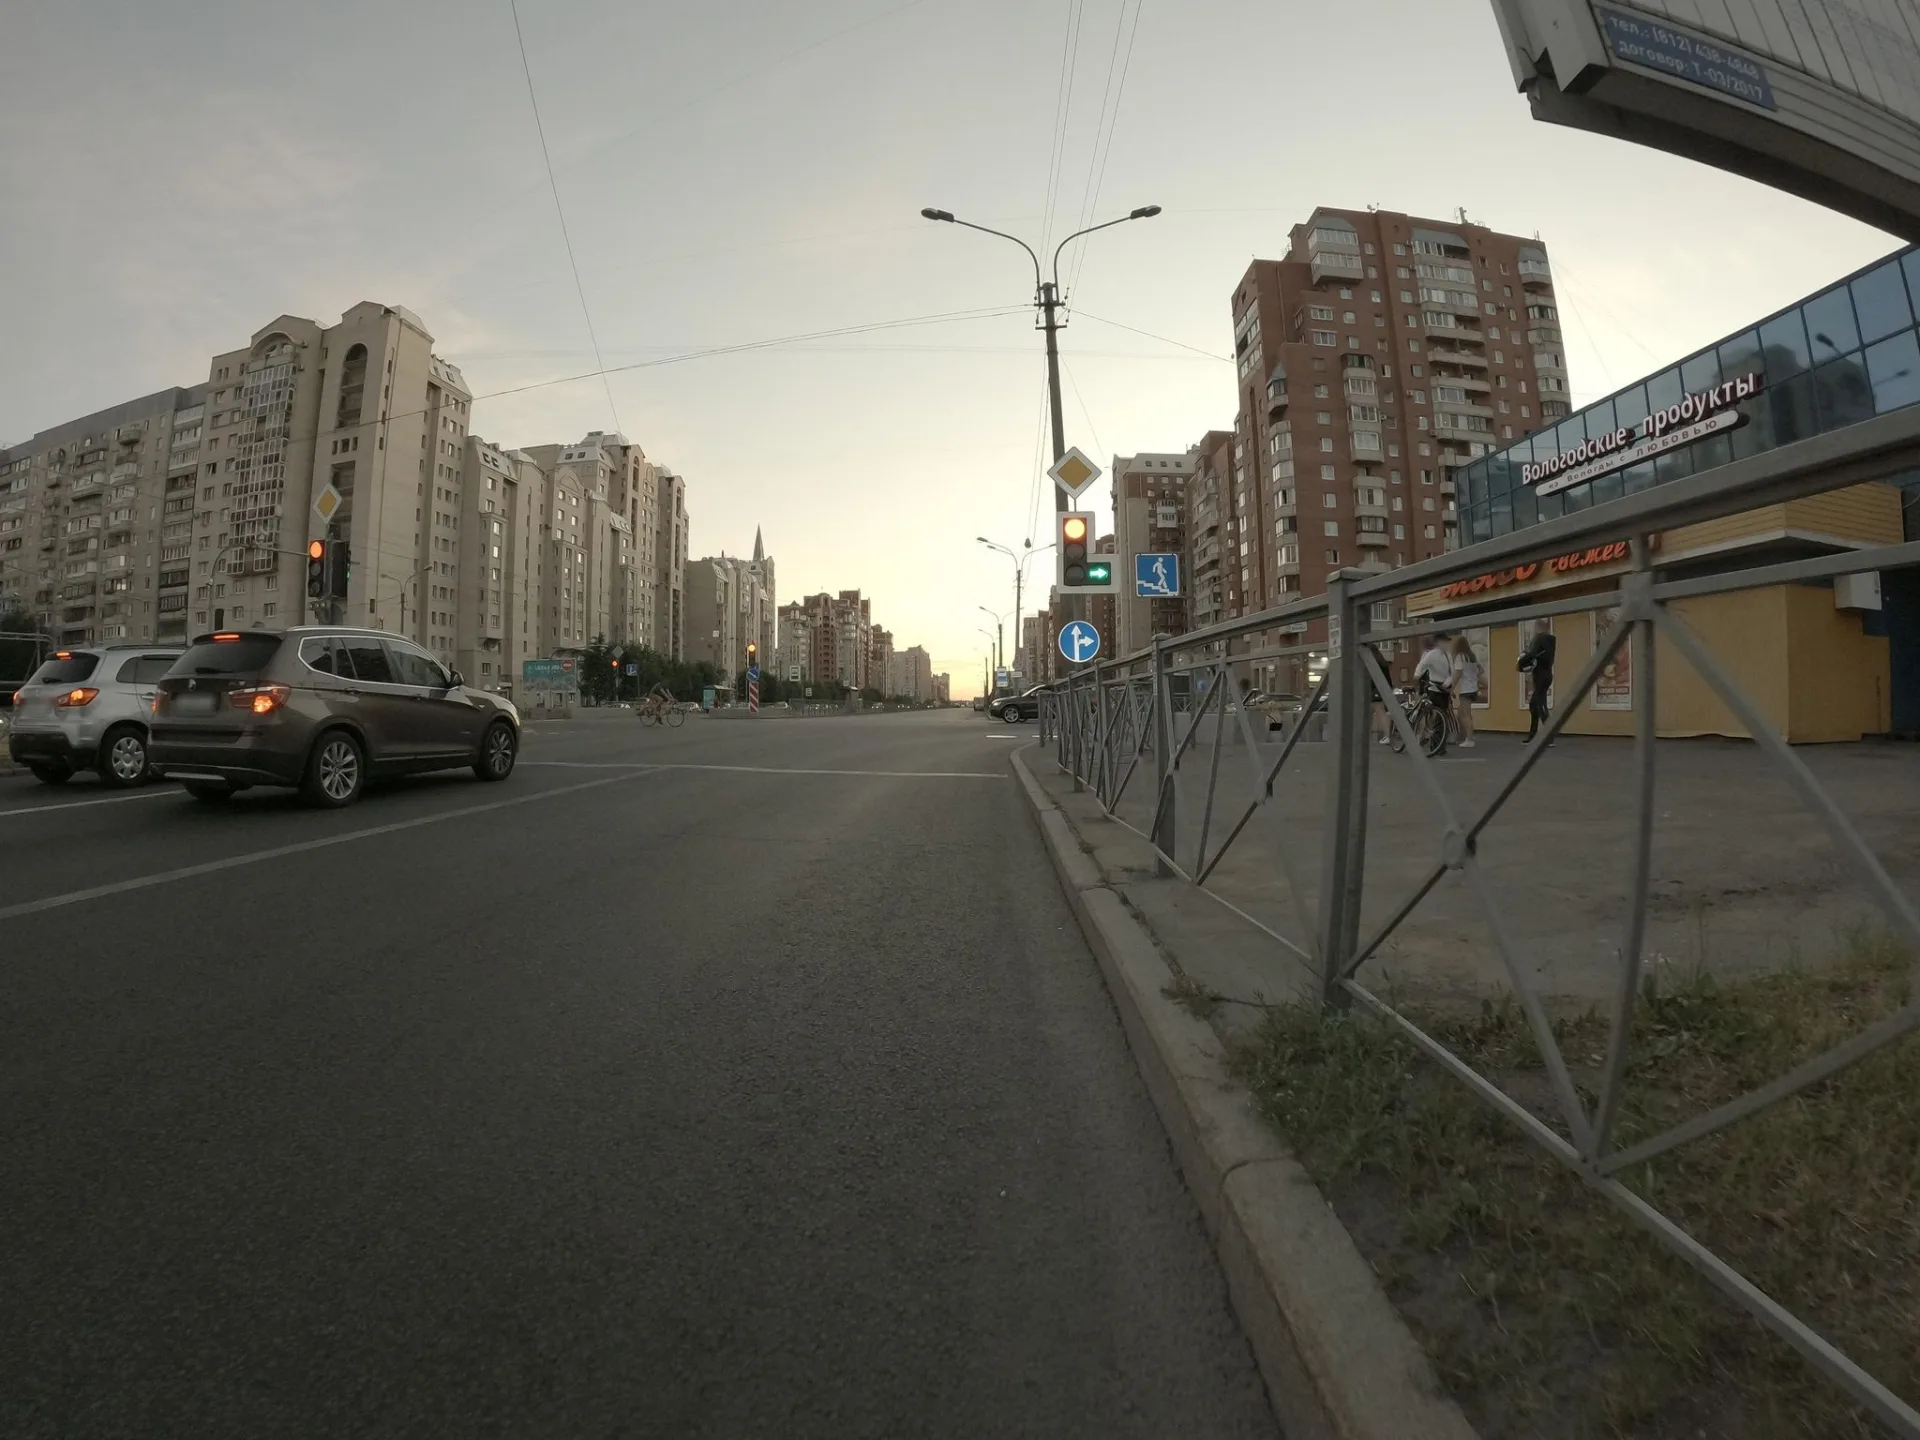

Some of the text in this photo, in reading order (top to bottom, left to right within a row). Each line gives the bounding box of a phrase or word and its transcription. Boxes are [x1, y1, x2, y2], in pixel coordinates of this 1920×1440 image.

[1652, 27, 1692, 55] (812)
[1522, 372, 1755, 485] Вологодские продукты
[1567, 459, 1615, 482] Вологды
[1636, 419, 1718, 458] ЛЮБОВЬЮ
